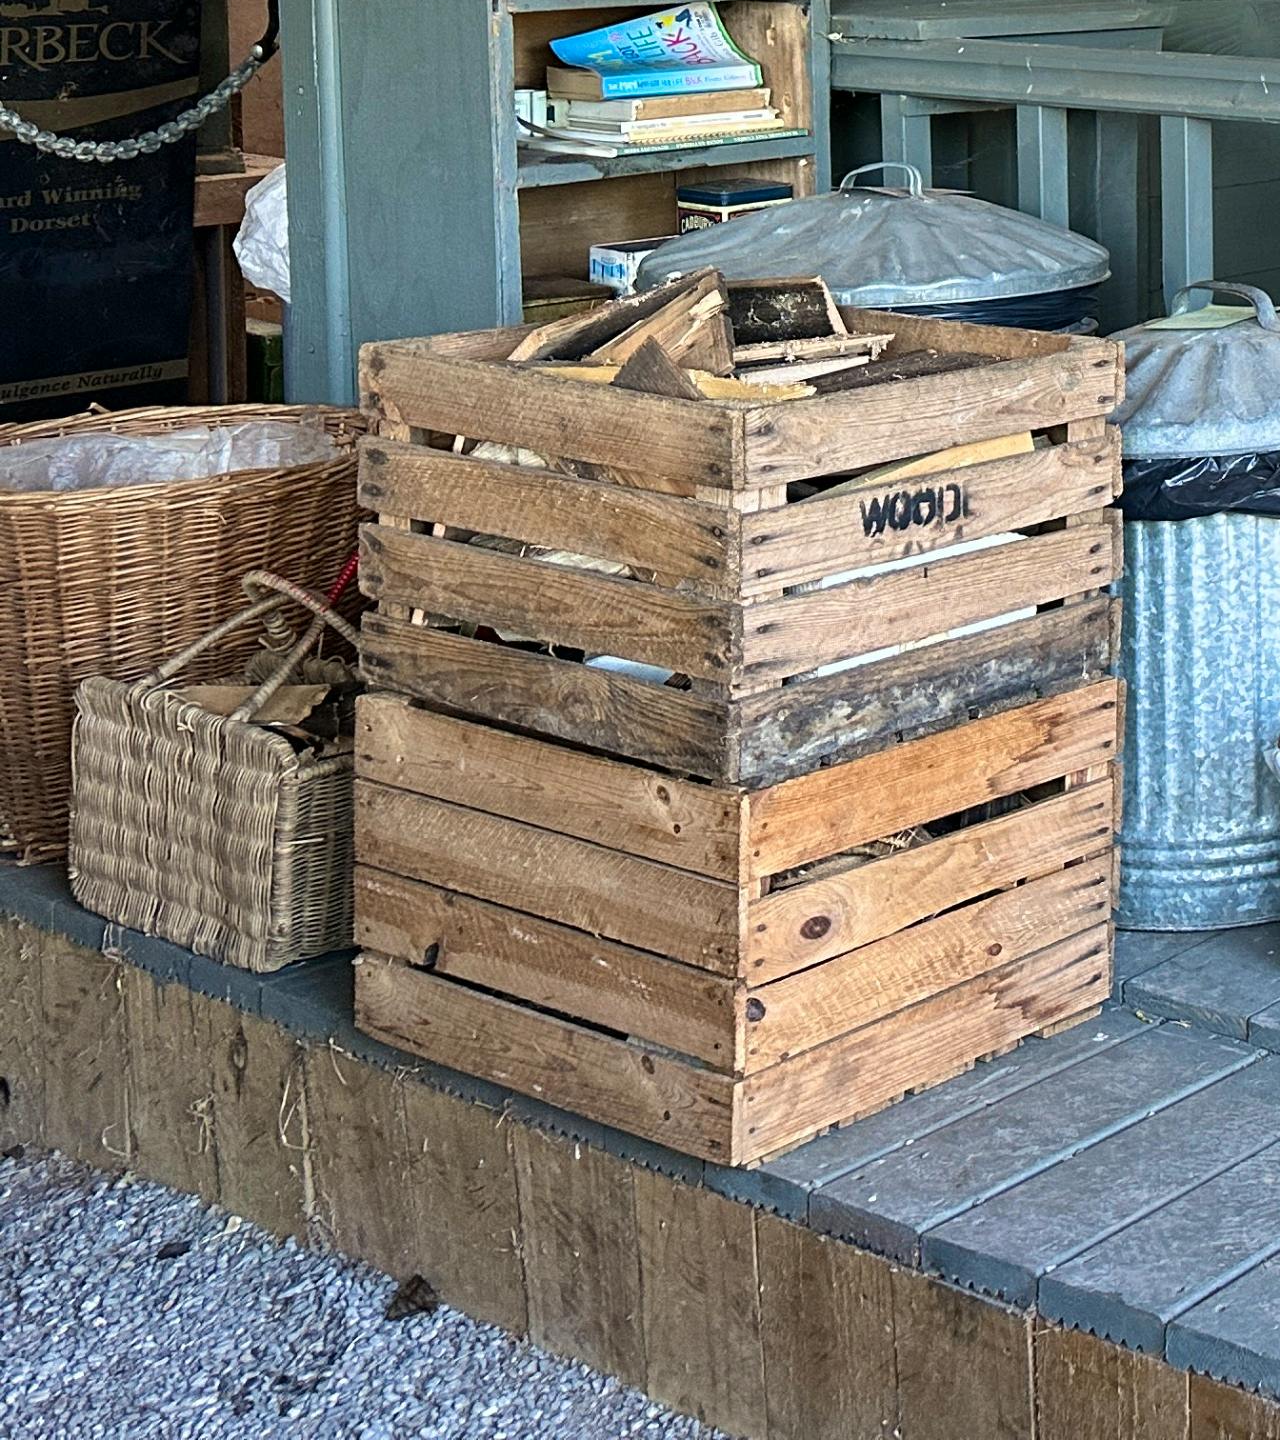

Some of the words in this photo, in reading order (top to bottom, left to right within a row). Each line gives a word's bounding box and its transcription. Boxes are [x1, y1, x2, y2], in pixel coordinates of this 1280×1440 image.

[41, 183, 143, 206] Winning
[9, 212, 92, 235] Dorset
[77, 365, 164, 390] Naturally
